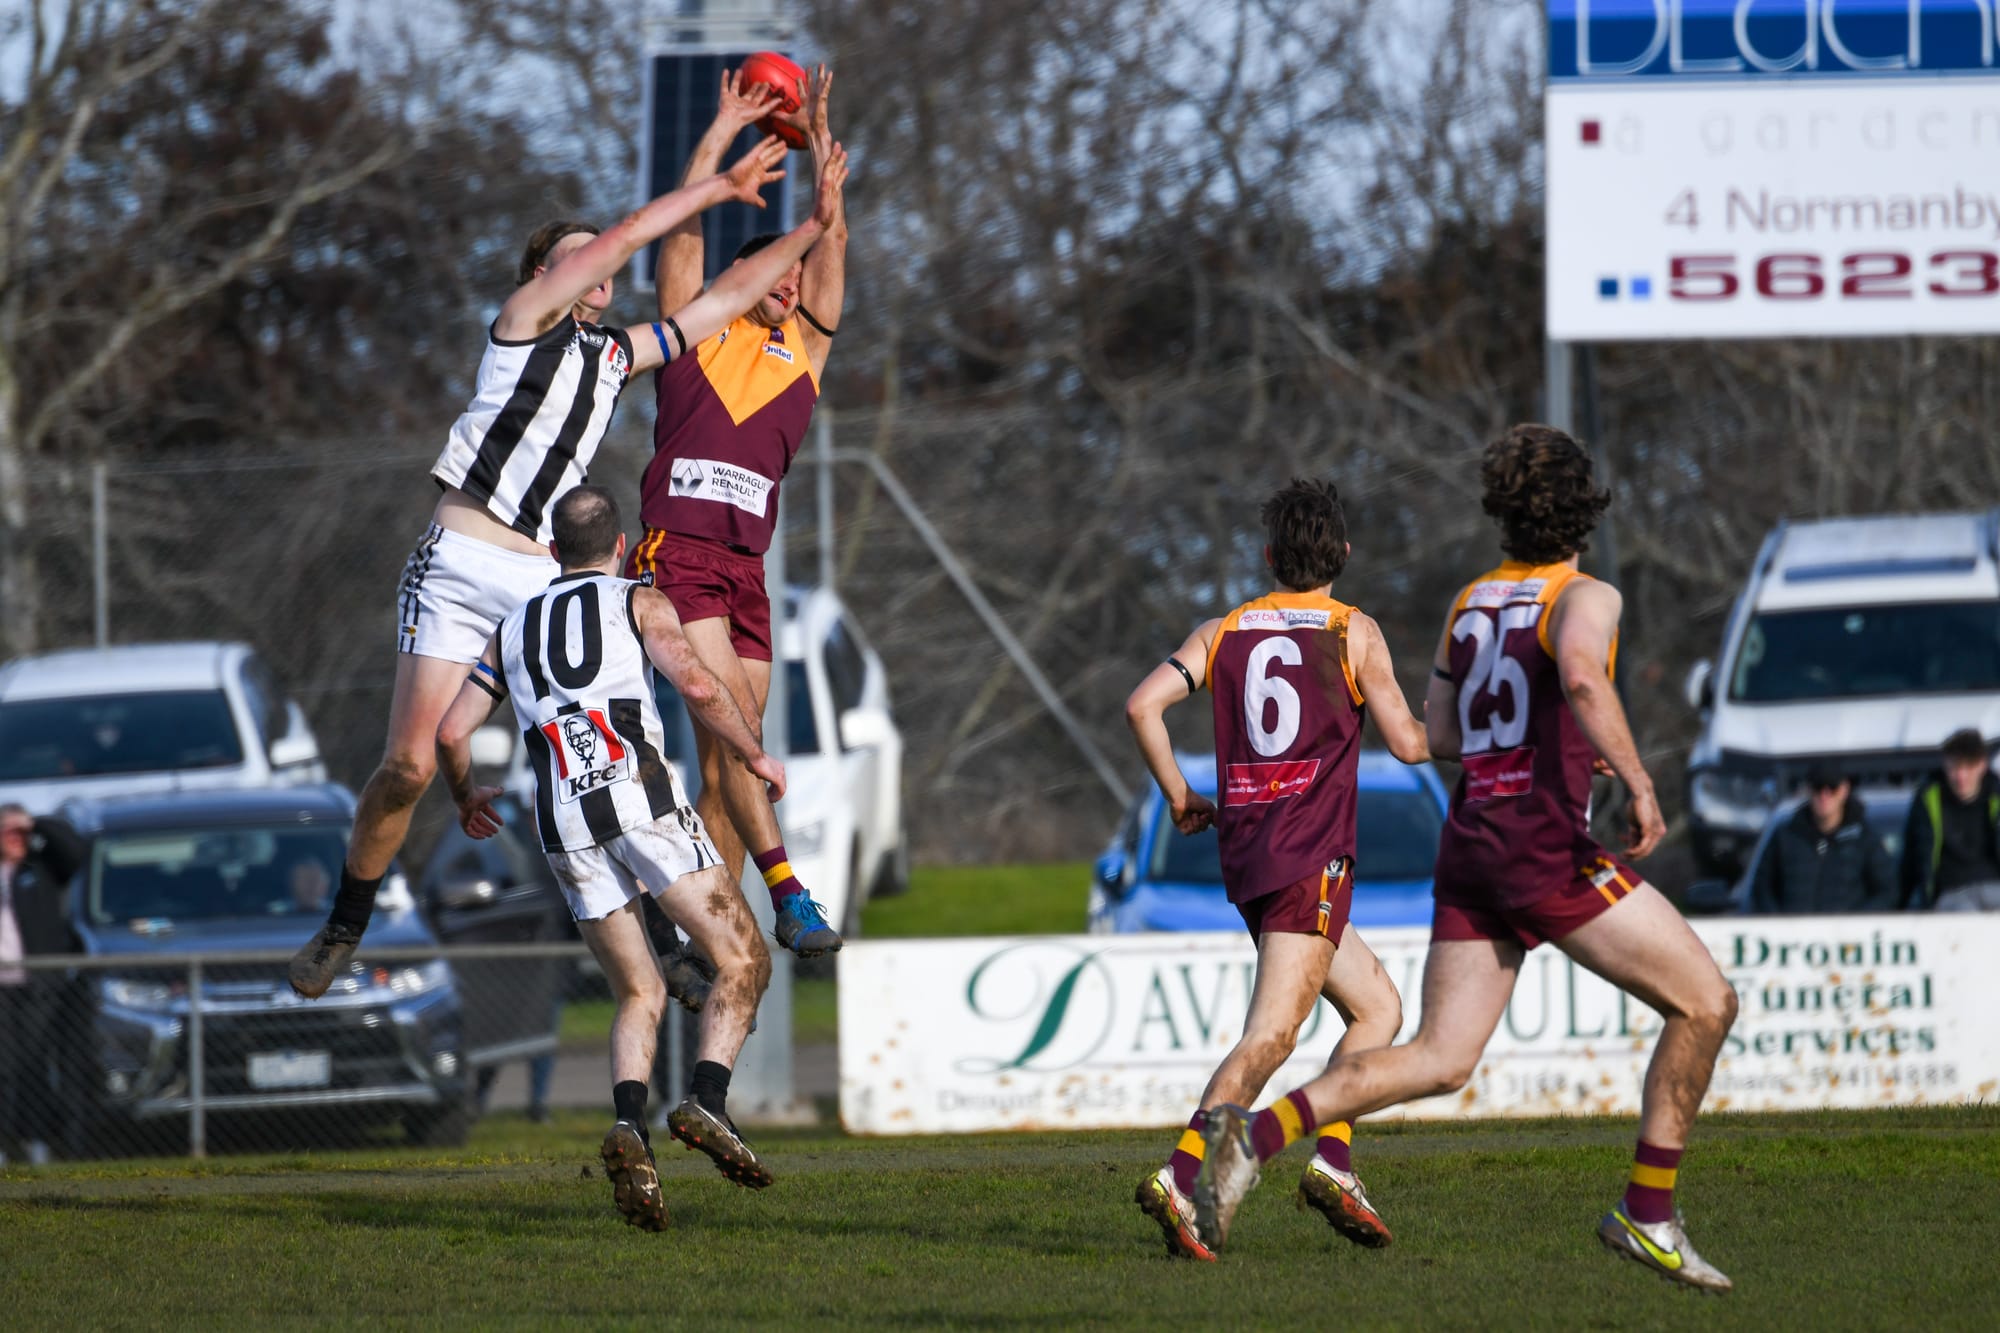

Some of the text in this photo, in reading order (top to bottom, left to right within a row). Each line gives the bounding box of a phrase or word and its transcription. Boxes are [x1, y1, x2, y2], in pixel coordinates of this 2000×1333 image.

[1664, 187, 1700, 230] 4
[1667, 250, 2000, 300] 5623
[711, 477, 757, 498] RENAULT
[712, 466, 767, 492] WARRAGUL
[1240, 612, 1259, 623] red
[1287, 611, 1327, 621] homes
[523, 582, 603, 702] 10
[1244, 635, 1303, 757] 6
[1452, 604, 1544, 754] 25
[569, 764, 617, 797] KFC
[1731, 930, 1919, 968] Drouin
[1727, 1024, 1937, 1056] Services
